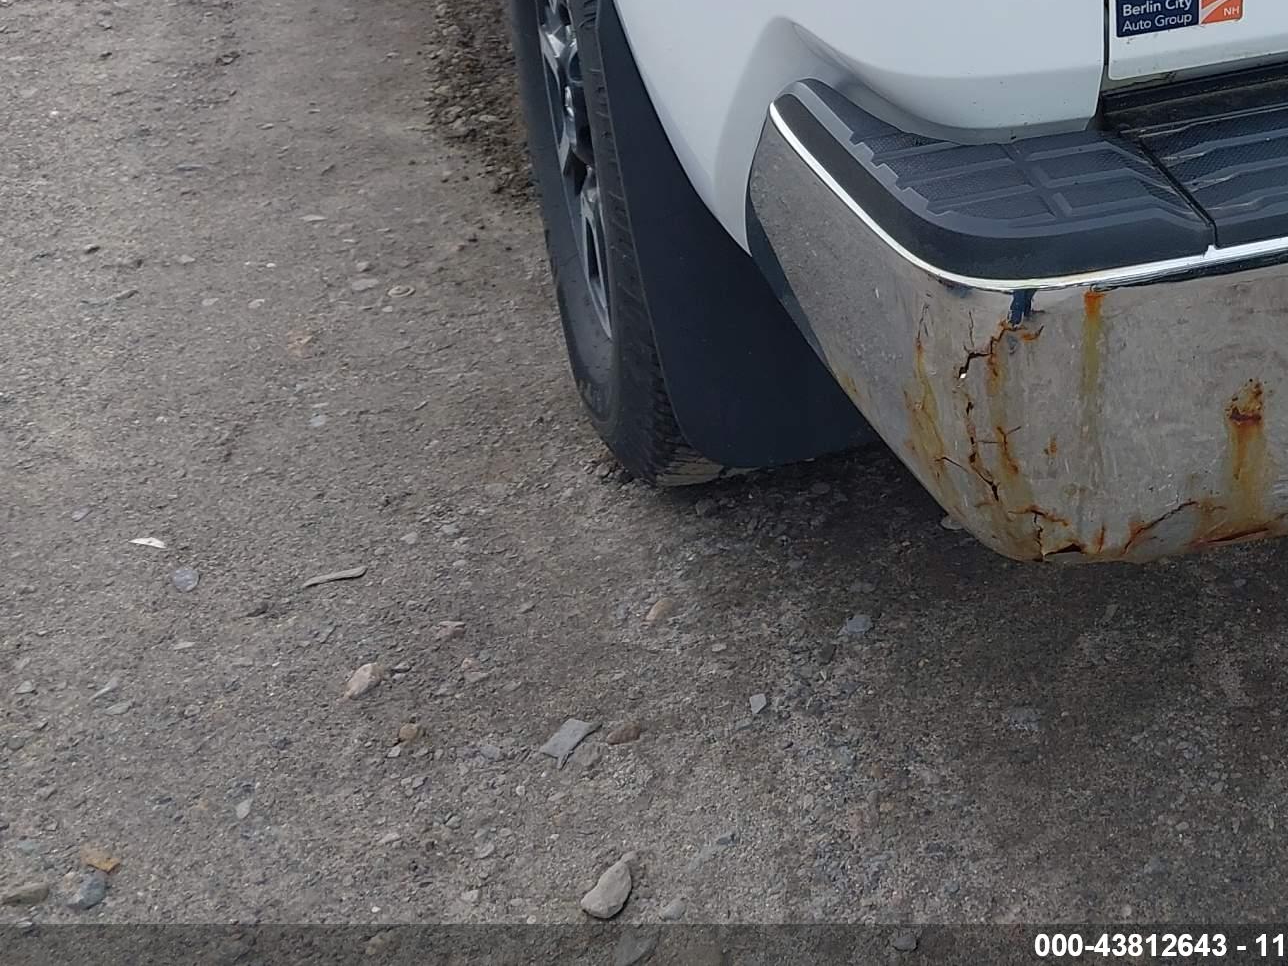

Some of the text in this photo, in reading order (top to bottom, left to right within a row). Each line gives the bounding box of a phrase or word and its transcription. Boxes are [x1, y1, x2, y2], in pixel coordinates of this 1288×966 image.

[1122, 1, 1161, 17] Berlin
[1223, 6, 1240, 17] NH
[1122, 13, 1193, 32] Auto Group
